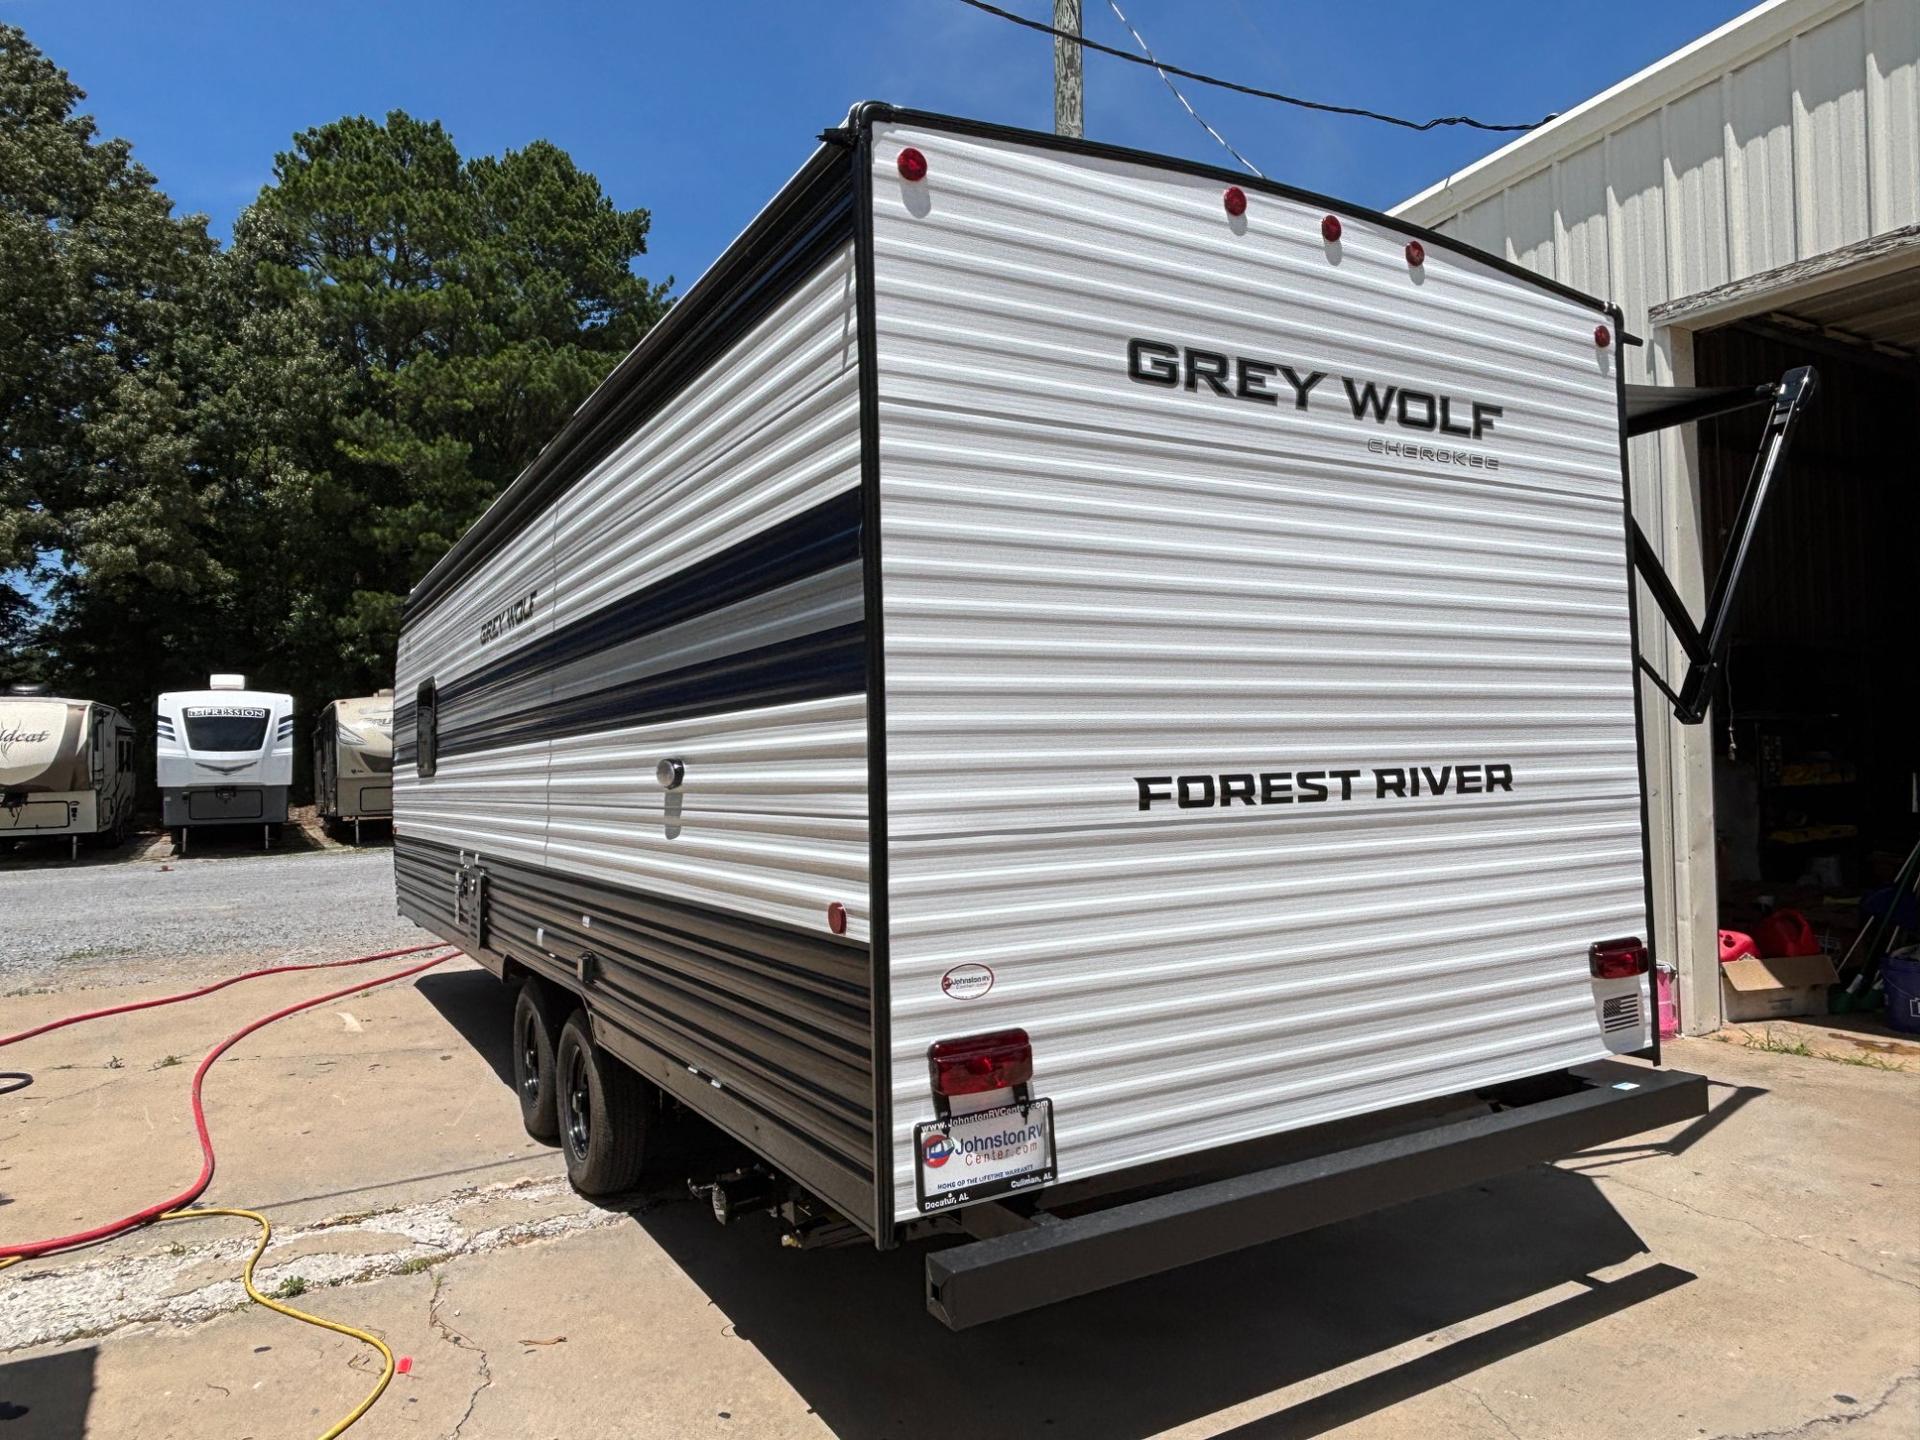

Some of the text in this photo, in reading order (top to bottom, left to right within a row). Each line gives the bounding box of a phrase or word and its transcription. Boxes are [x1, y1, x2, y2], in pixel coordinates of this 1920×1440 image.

[1127, 337, 1503, 440] GREY WOLF
[1367, 438, 1500, 470] CHEROKEE
[480, 589, 538, 646] GREY WOLF
[1133, 763, 1514, 811] FOREST RIVER
[954, 1123, 1043, 1155] Johnston RV
[965, 1142, 1038, 1166] Center.com
[937, 1181, 956, 1190] HOME
[966, 1177, 978, 1185] THE
[1043, 1172, 1053, 1181] AL
[959, 1192, 970, 1202] AL
